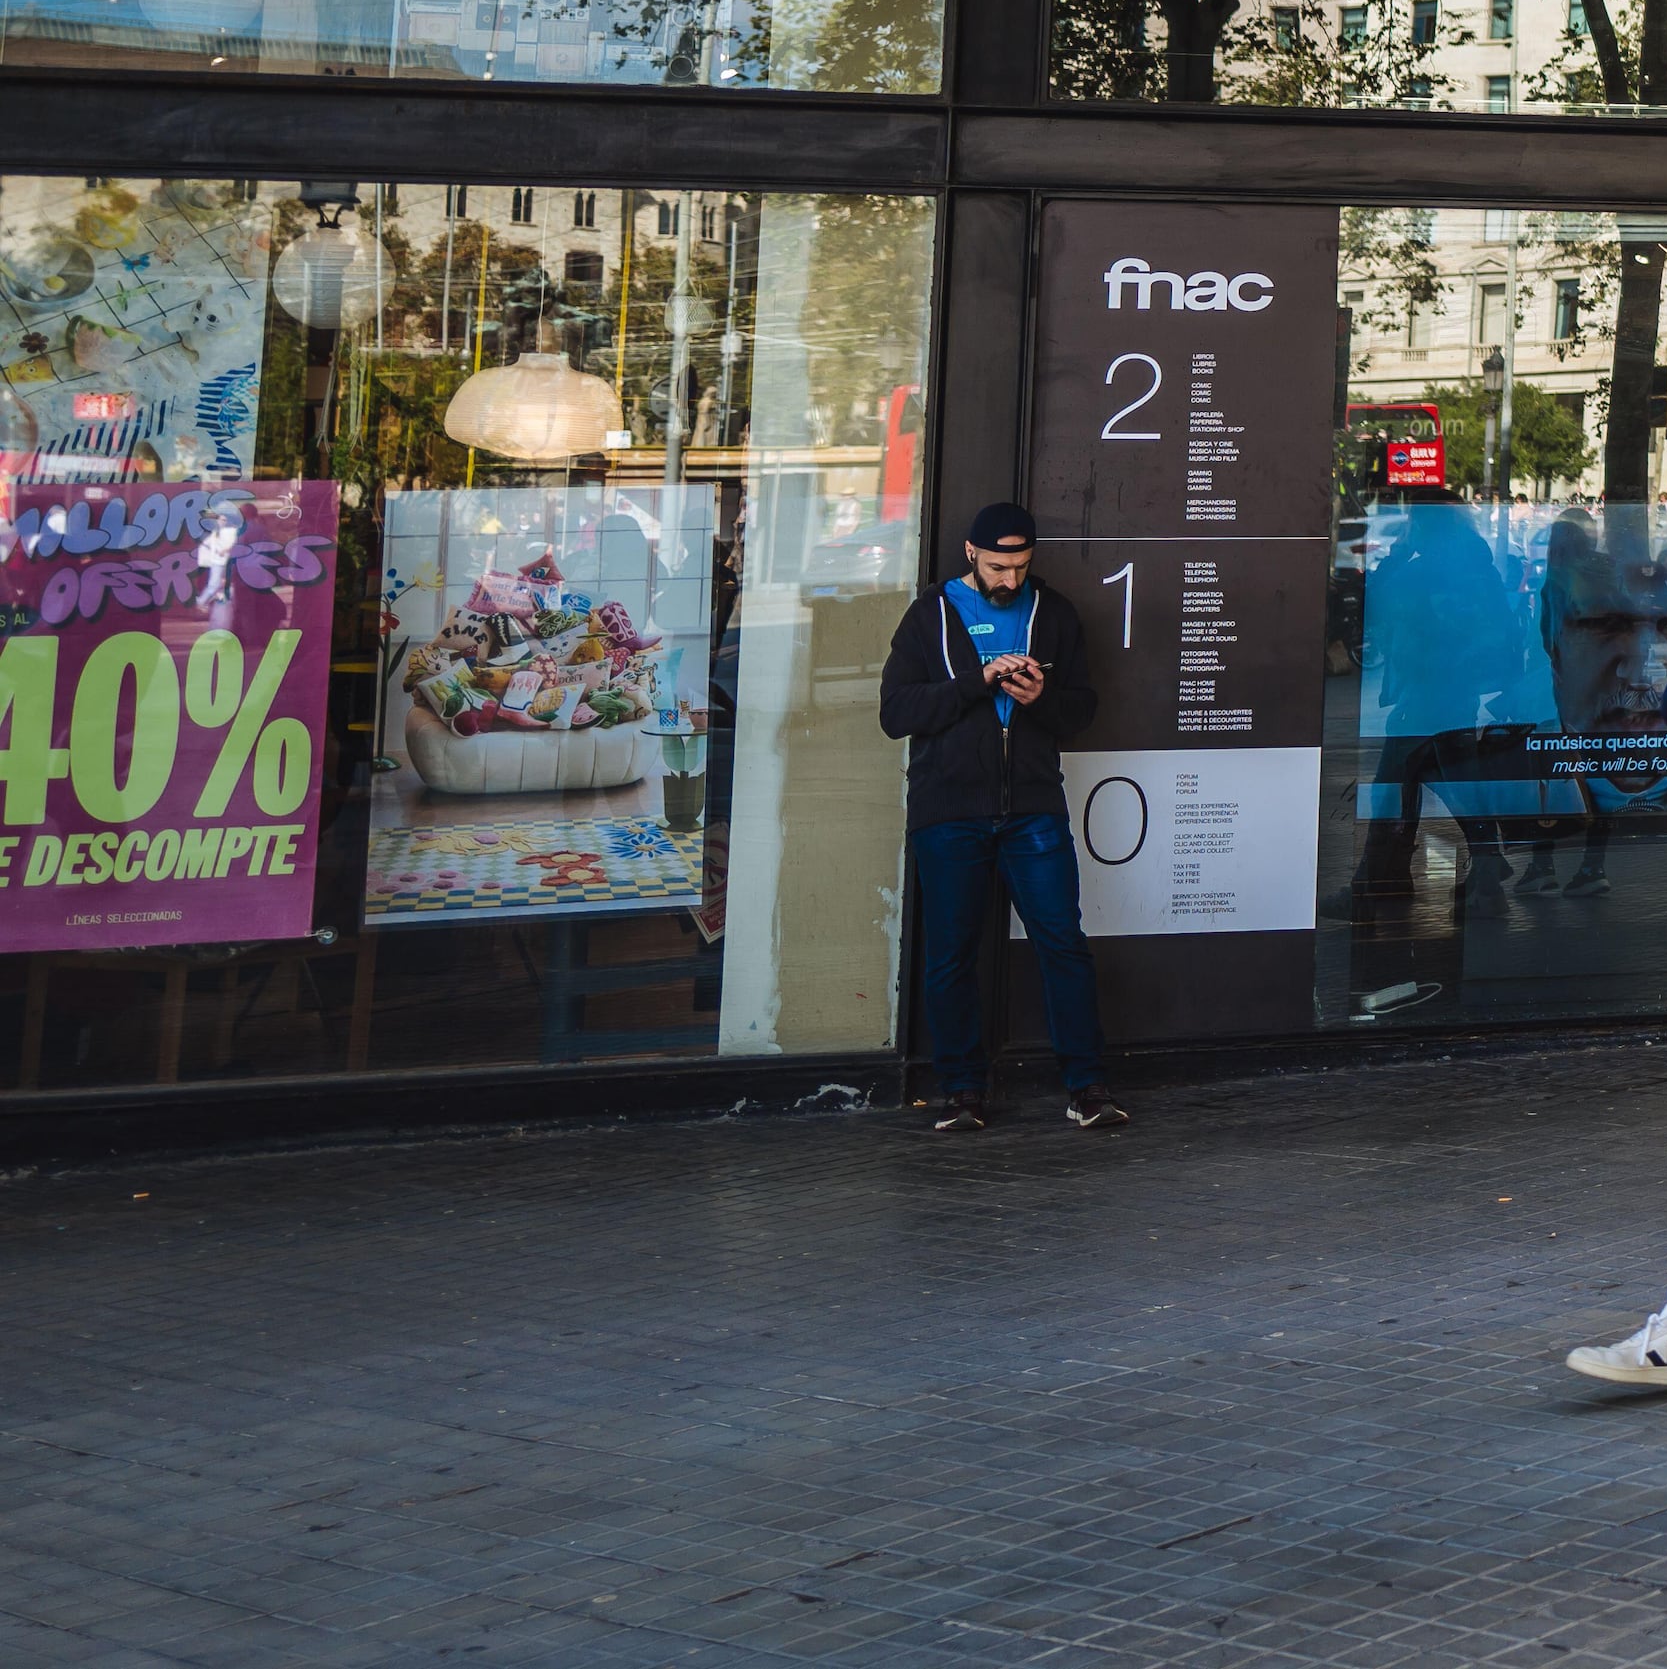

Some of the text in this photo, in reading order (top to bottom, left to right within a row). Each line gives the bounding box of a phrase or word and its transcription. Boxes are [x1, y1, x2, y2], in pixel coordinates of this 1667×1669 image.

[1104, 258, 1274, 312] fnac
[1101, 353, 1162, 440] 2
[1103, 562, 1134, 649] 1
[0, 629, 312, 825] 40%
[1526, 736, 1542, 752] la
[1544, 735, 1603, 751] música
[1553, 759, 1598, 773] music
[1602, 757, 1625, 772] will
[1627, 757, 1648, 772] be
[1084, 776, 1148, 865] 0
[23, 824, 305, 888] DESCOMPTE
[106, 910, 182, 924] SELECCIONADAS
